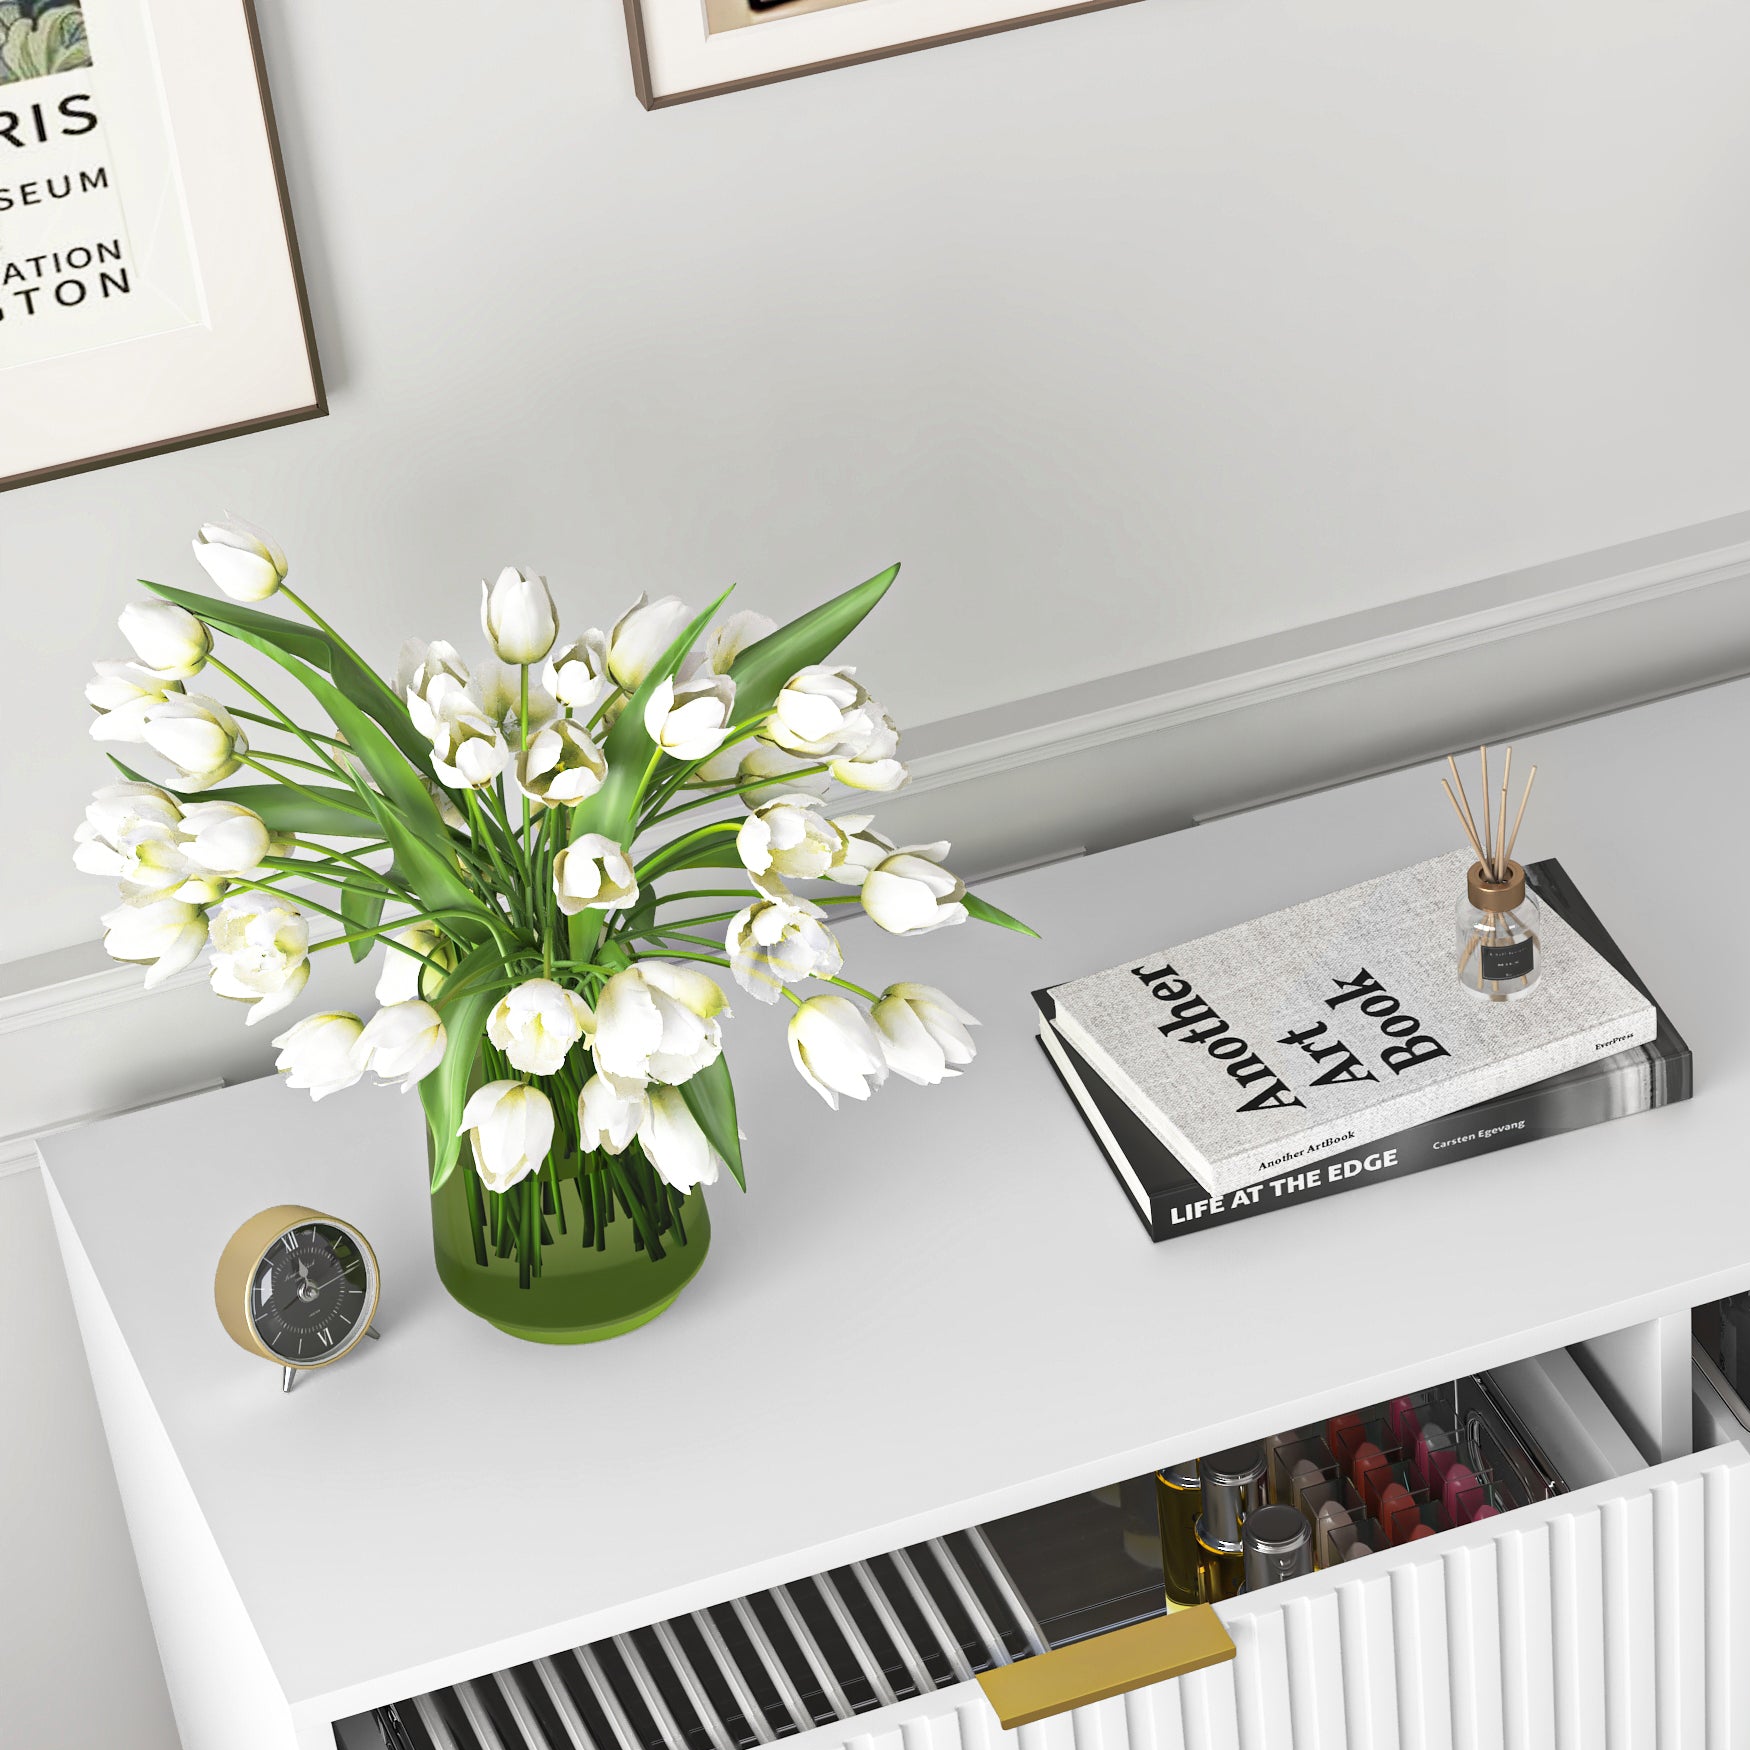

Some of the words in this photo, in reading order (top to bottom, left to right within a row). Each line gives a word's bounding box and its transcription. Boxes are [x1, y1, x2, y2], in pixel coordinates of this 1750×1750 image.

[3, 239, 121, 285] ATION
[0, 267, 130, 322] TON
[1131, 964, 1307, 1113] Another
[1331, 967, 1452, 1076] Book
[1594, 1032, 1634, 1051] EverPress
[1276, 1020, 1379, 1087] Art
[1258, 1149, 1305, 1172] Another
[1306, 1130, 1356, 1154] ArtBook
[1432, 1132, 1476, 1150] Carsten
[1478, 1119, 1526, 1139] Egevang
[1170, 1195, 1225, 1225] LIFE
[1230, 1184, 1264, 1209] AT
[1269, 1169, 1322, 1198] THE
[1328, 1148, 1399, 1183] EDGE
